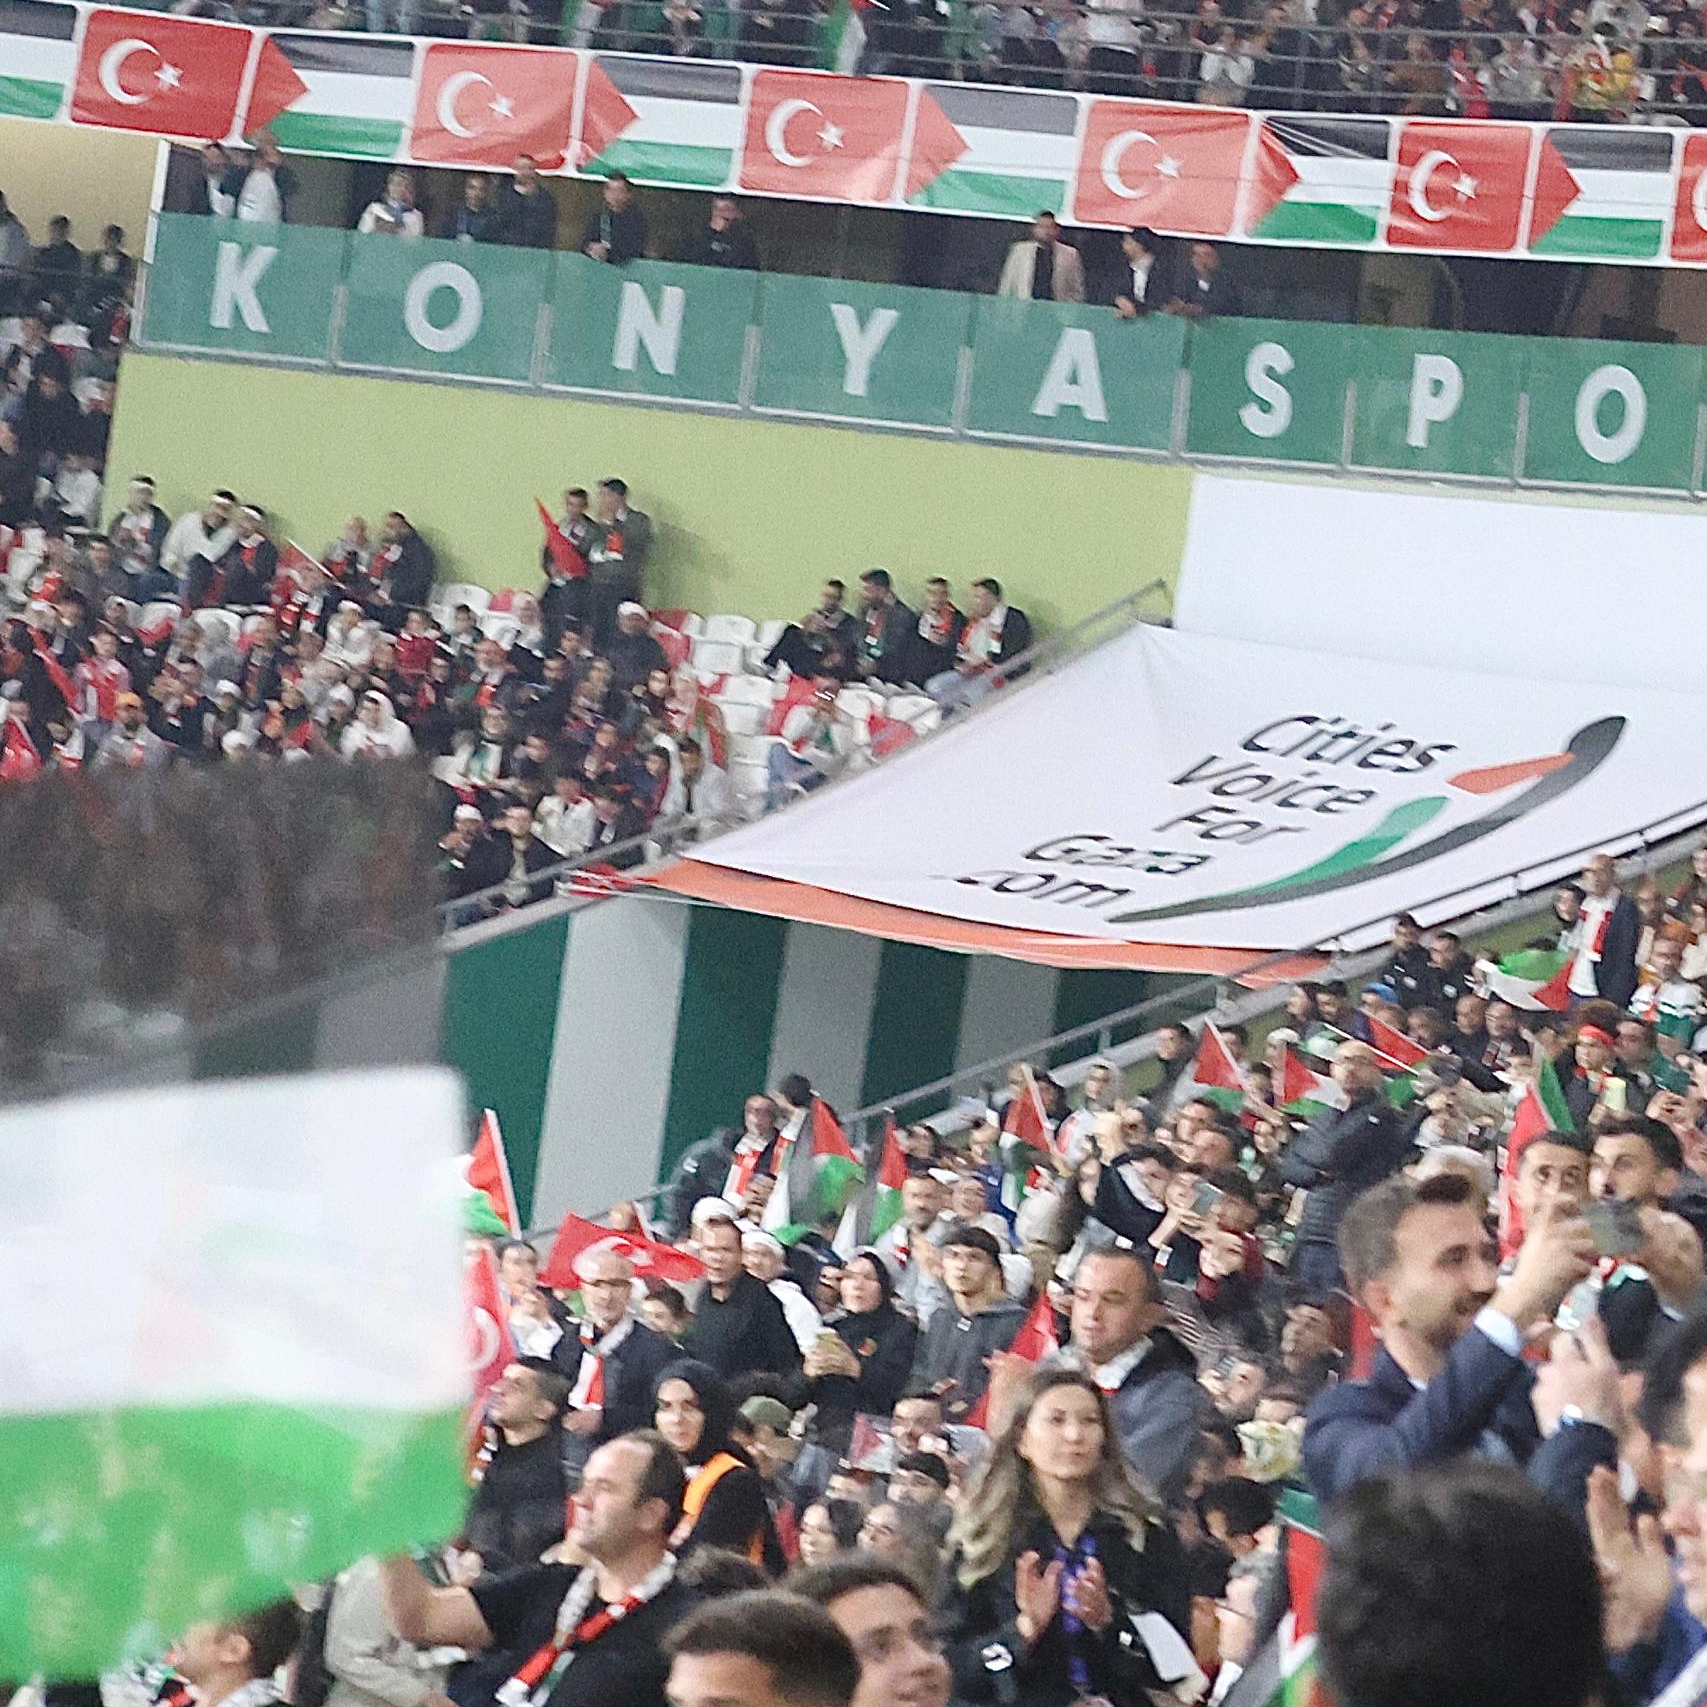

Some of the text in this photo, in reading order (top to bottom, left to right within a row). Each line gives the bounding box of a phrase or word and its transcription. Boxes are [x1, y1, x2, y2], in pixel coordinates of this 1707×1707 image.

[1238, 715, 1458, 773] Cities
[1167, 755, 1380, 813] Voice
[1152, 805, 1310, 845] For
